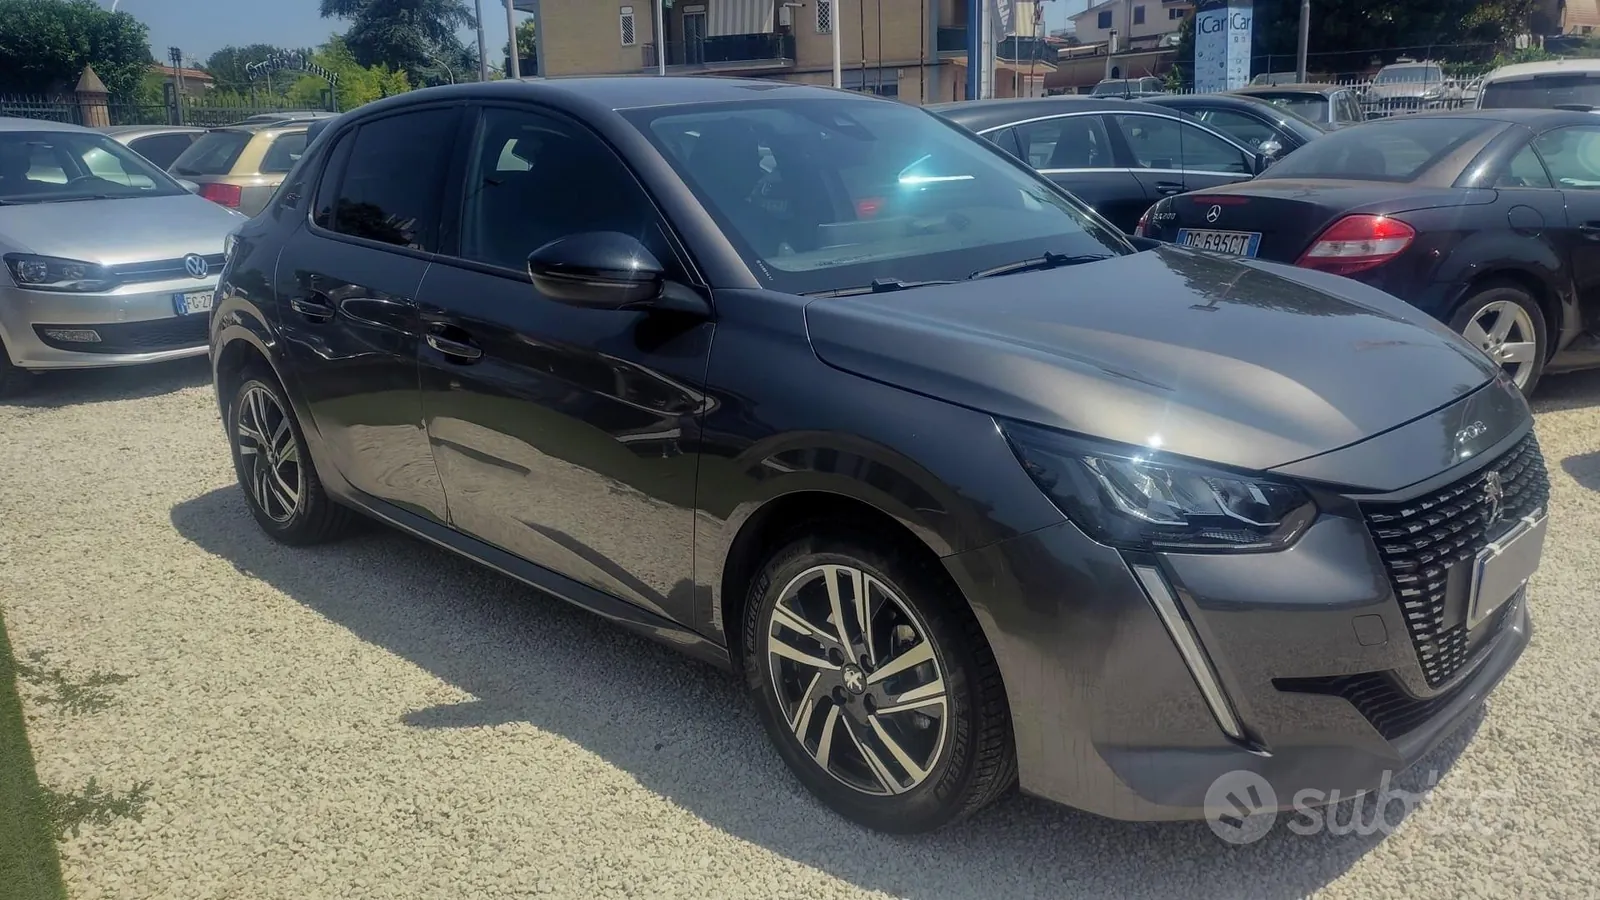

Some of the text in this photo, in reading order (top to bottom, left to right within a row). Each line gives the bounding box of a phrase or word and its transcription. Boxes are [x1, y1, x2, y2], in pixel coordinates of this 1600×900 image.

[1198, 16, 1227, 35] iCar
[1230, 13, 1251, 30] iCar
[1455, 420, 1487, 444] 208
[746, 574, 769, 651] MICHELIN
